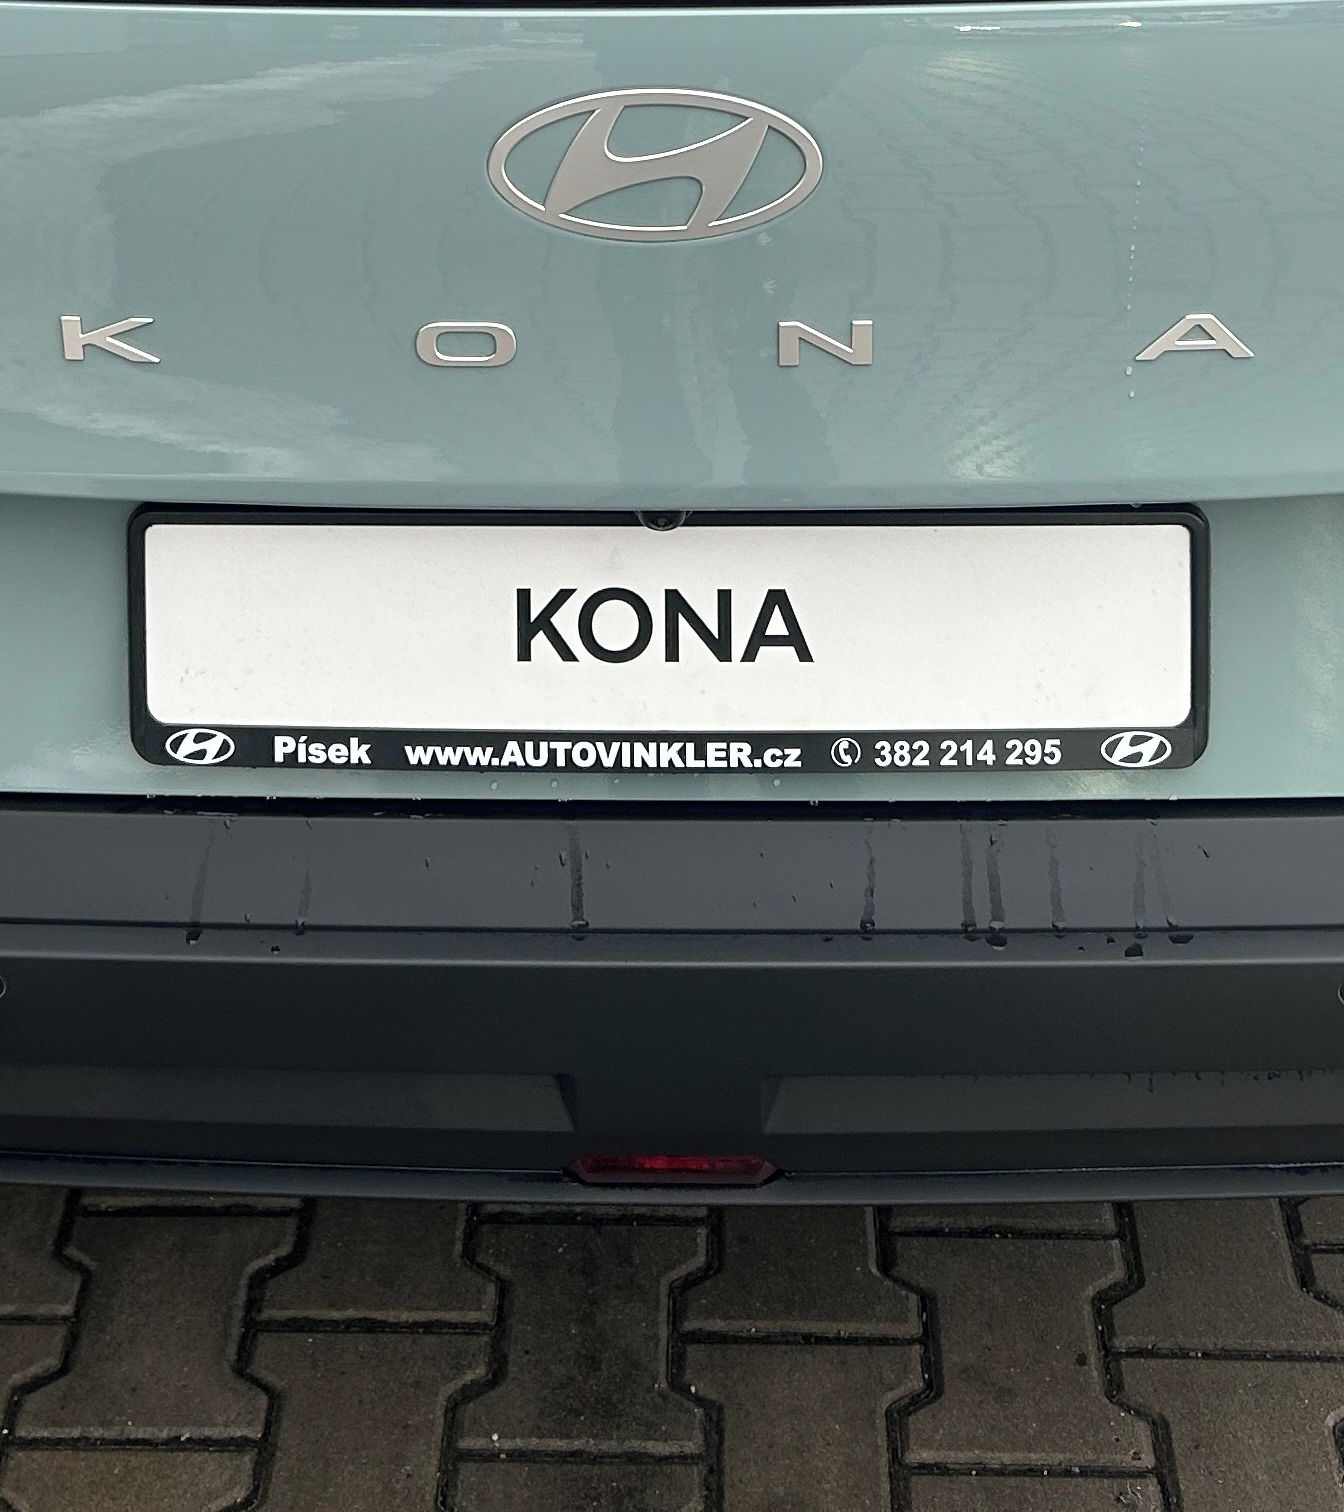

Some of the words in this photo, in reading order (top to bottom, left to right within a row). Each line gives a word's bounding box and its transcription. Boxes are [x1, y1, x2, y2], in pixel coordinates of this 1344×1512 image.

[60, 314, 1255, 367] KONA
[516, 586, 815, 664] KONA
[273, 734, 372, 765] Písek
[404, 740, 802, 769] www.AUTOVINKLER.cz
[873, 740, 930, 768] 382
[939, 740, 997, 767] 214
[1004, 738, 1063, 766] 295
